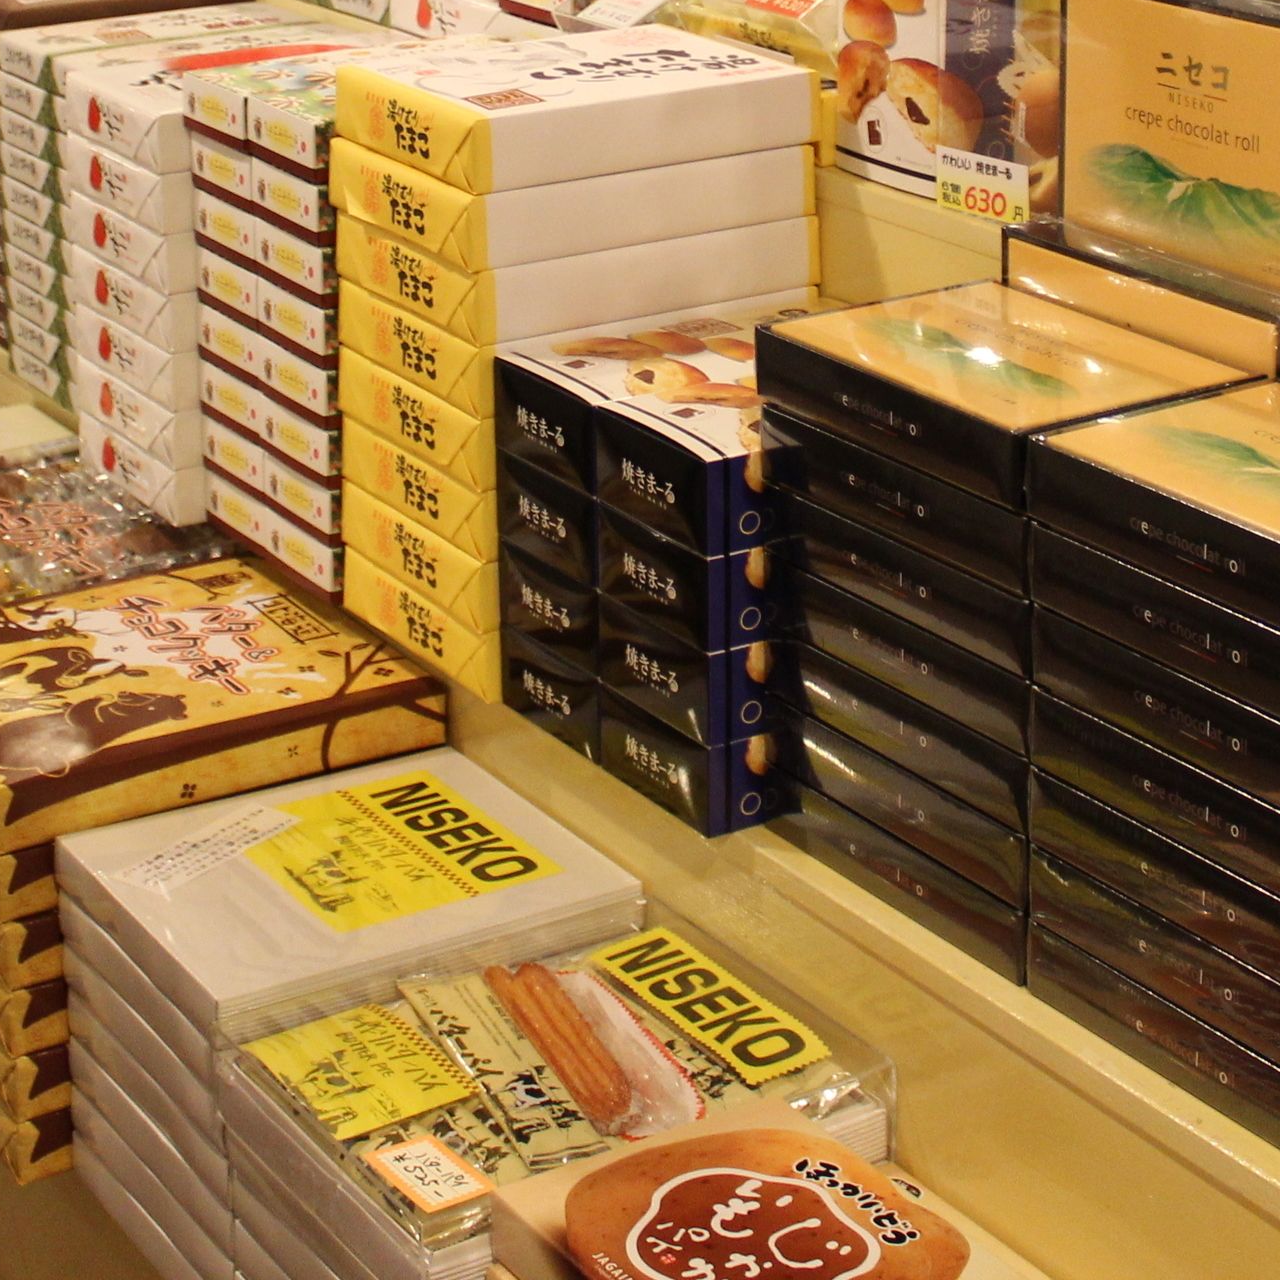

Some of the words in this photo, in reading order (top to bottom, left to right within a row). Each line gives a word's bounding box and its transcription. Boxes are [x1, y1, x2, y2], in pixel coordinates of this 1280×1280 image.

[1155, 51, 1230, 91] ニセコ
[1167, 91, 1215, 113] NISEKO
[1125, 104, 1163, 129] crepe
[1166, 112, 1230, 146] chocolat
[1234, 131, 1261, 154] roll
[942, 153, 972, 171] かわいい
[964, 185, 1007, 217] 630
[516, 404, 565, 448] 焼きまーる
[621, 457, 676, 504] 焼きまーる
[519, 495, 566, 539] 焼きまーる
[623, 552, 677, 600] 焼きまーる
[521, 583, 570, 628] 焼きまーる
[624, 643, 679, 693] 焼きまーる
[522, 669, 571, 716] 焼きまーる
[624, 733, 680, 785] 焼きまーる
[370, 780, 539, 884] NISEKO
[606, 935, 809, 1068] NISEKO
[793, 1157, 920, 1246] ほっかいどう
